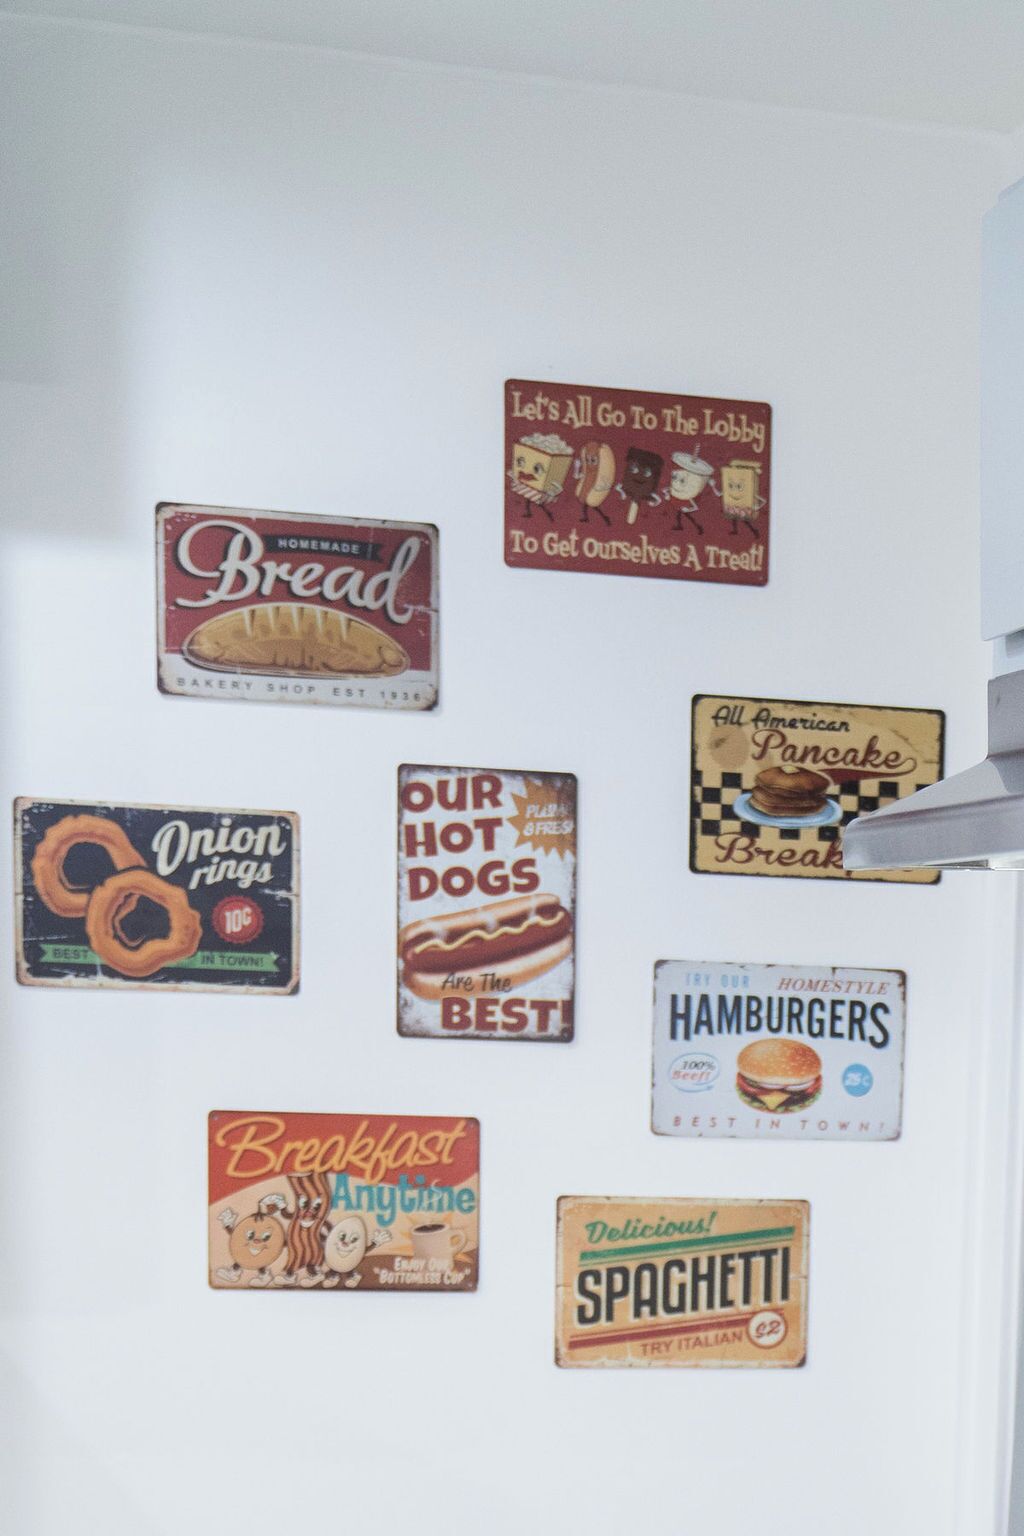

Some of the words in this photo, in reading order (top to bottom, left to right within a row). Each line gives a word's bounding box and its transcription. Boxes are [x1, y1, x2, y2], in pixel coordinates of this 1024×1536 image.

[512, 391, 560, 421] Let's
[562, 395, 592, 429] All
[597, 402, 626, 427] Go
[631, 405, 657, 430] To
[662, 405, 699, 436] The
[703, 409, 765, 454] Lobby
[277, 538, 360, 554] HOMEMADE
[510, 530, 539, 554] To
[543, 529, 579, 558] Get
[583, 535, 680, 566] Ourselves
[684, 545, 703, 572] A
[705, 544, 764, 572] Treat!
[175, 519, 420, 624] Bread
[176, 677, 252, 690] BAKERY
[267, 683, 315, 694] SHOP
[332, 687, 365, 698] EST
[711, 705, 744, 727] All
[751, 708, 851, 732] American
[751, 729, 913, 772] Pancake
[401, 774, 503, 813] OUR
[152, 817, 287, 877] Onion
[404, 818, 503, 858] HOT
[715, 833, 850, 875] Break
[188, 857, 273, 890] rings
[408, 858, 540, 901] DOGS
[53, 948, 89, 961] BEST
[200, 952, 216, 965] IN
[219, 953, 264, 968] TOWN!
[441, 971, 474, 993] Are
[480, 974, 513, 993] The
[685, 973, 711, 987] TRY
[721, 974, 749, 989] OUR
[776, 977, 890, 996] HOMESTYLE
[441, 996, 573, 1033] BEST!
[670, 993, 890, 1049] HAMBURGERS
[673, 1116, 736, 1129] BEST
[755, 1118, 780, 1130] IN
[215, 1116, 467, 1184] Breakfast
[331, 1173, 476, 1227] Anytime
[585, 1210, 718, 1245] Delicious!
[576, 1246, 790, 1326] SPAGHETTI
[640, 1339, 674, 1357] TRY
[678, 1331, 745, 1351] ITALIAN
